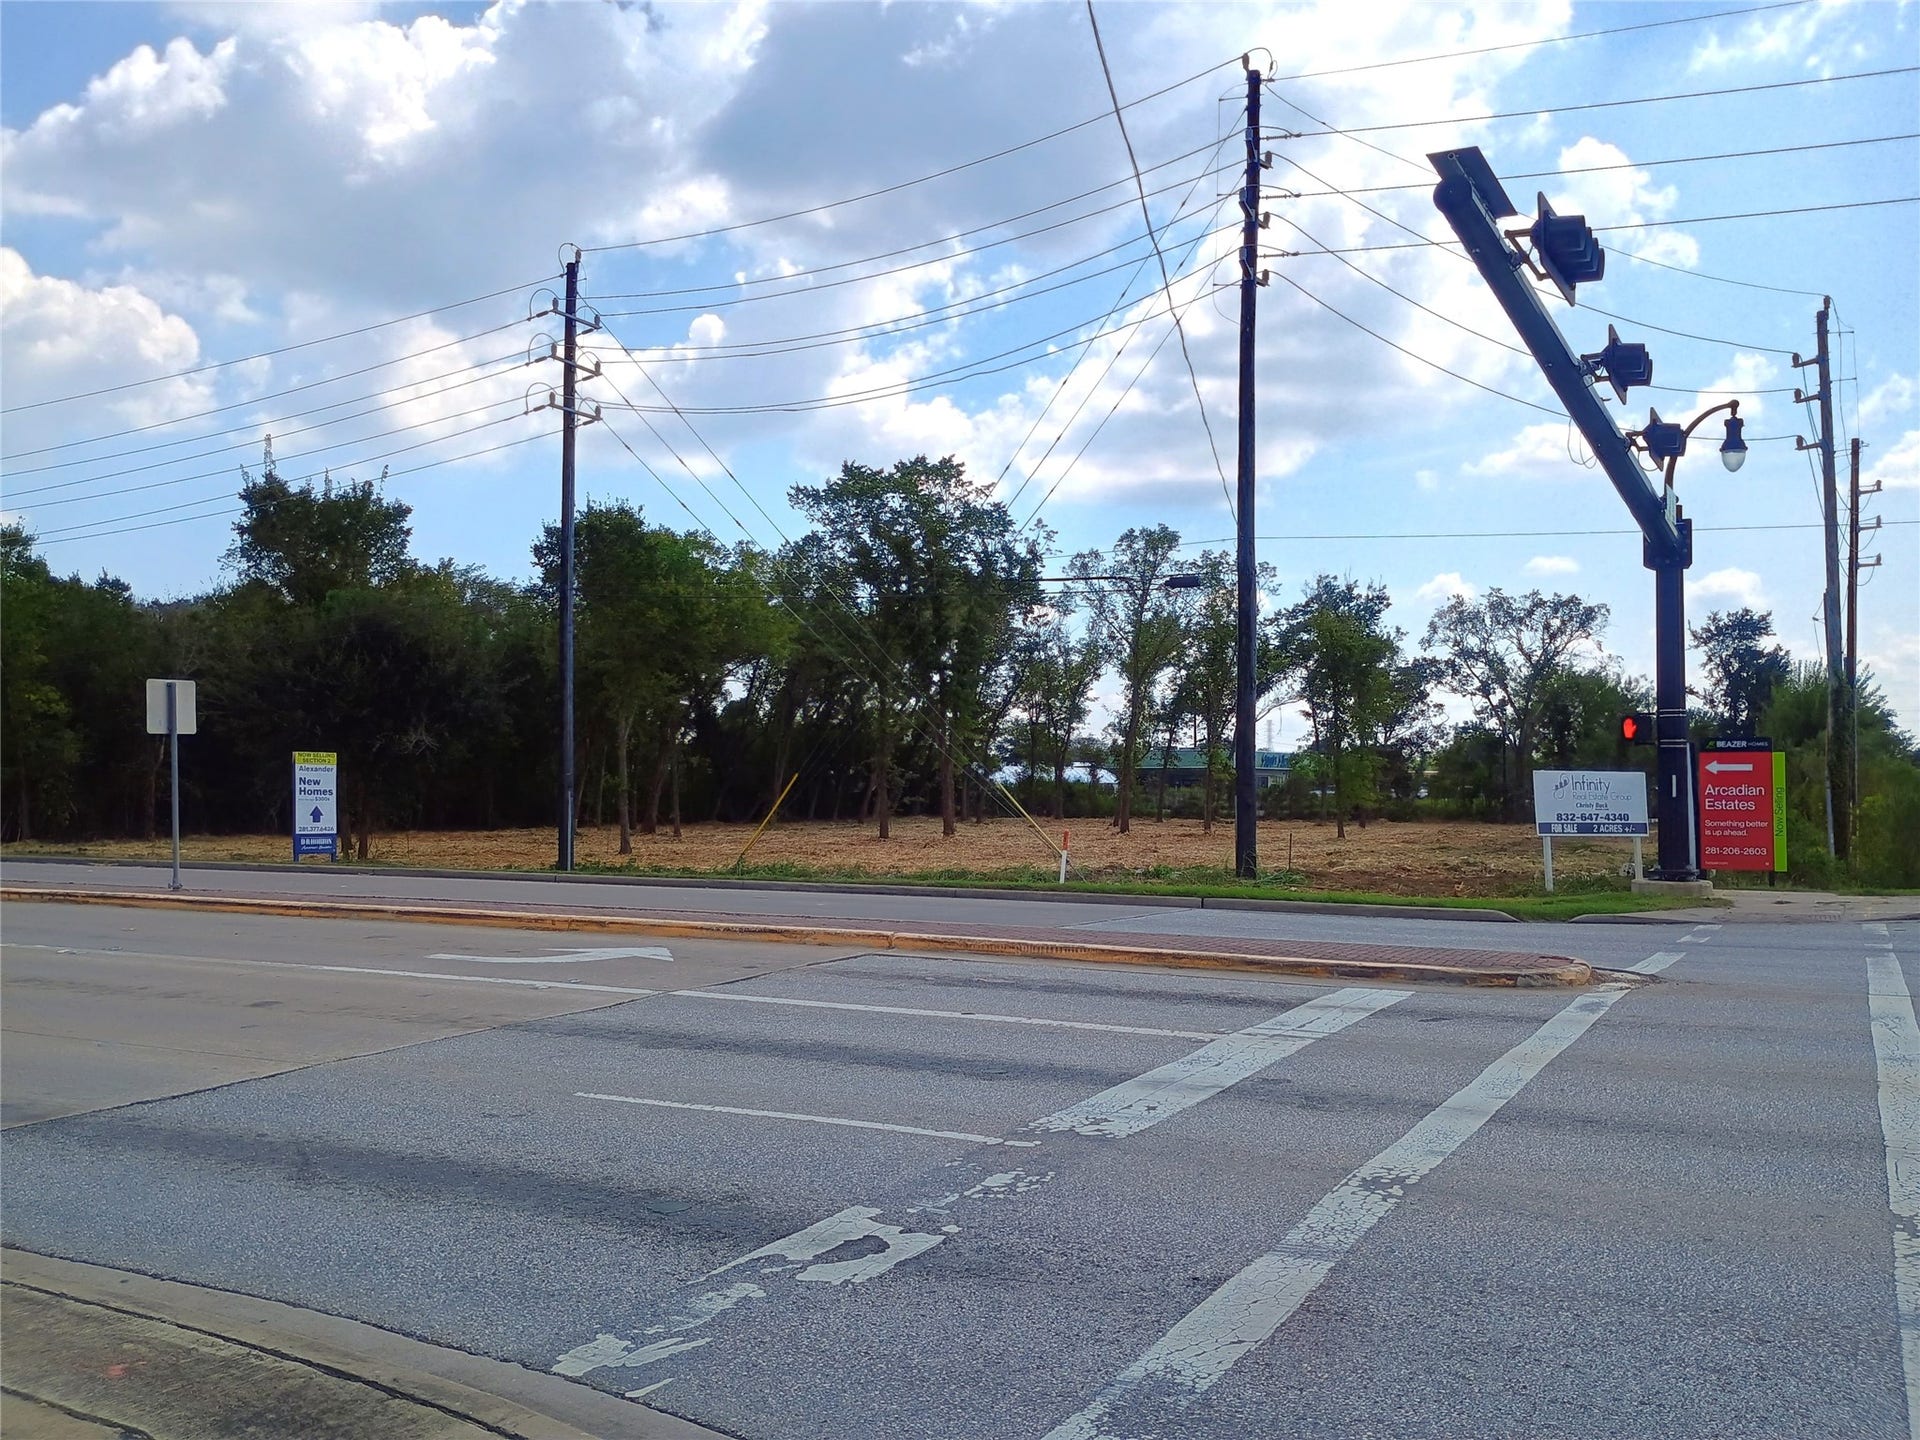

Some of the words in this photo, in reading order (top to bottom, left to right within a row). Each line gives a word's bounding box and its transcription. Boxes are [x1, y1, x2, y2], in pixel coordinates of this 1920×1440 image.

[1716, 740, 1747, 748] BEAZER
[299, 777, 321, 786] New
[1571, 774, 1610, 794] Infinity
[299, 787, 334, 796] Homes
[1705, 784, 1765, 796] Arcadian
[1572, 792, 1587, 801] Real
[1588, 793, 1609, 801] Estate
[1610, 792, 1632, 801] Group
[1775, 787, 1784, 816] Selling
[1575, 802, 1594, 810] Christy
[1705, 798, 1756, 811] Estates
[1556, 812, 1630, 822] 832-647-4340
[1551, 824, 1563, 833] FOR
[1563, 823, 1578, 833] SALE
[1593, 824, 1598, 833] 2
[1599, 824, 1623, 833] ACRES
[1705, 820, 1745, 828] Something
[1776, 817, 1785, 837] Now
[1712, 829, 1722, 837] up
[1723, 829, 1748, 837] ahead.
[1705, 846, 1767, 856] 281-206-2603
